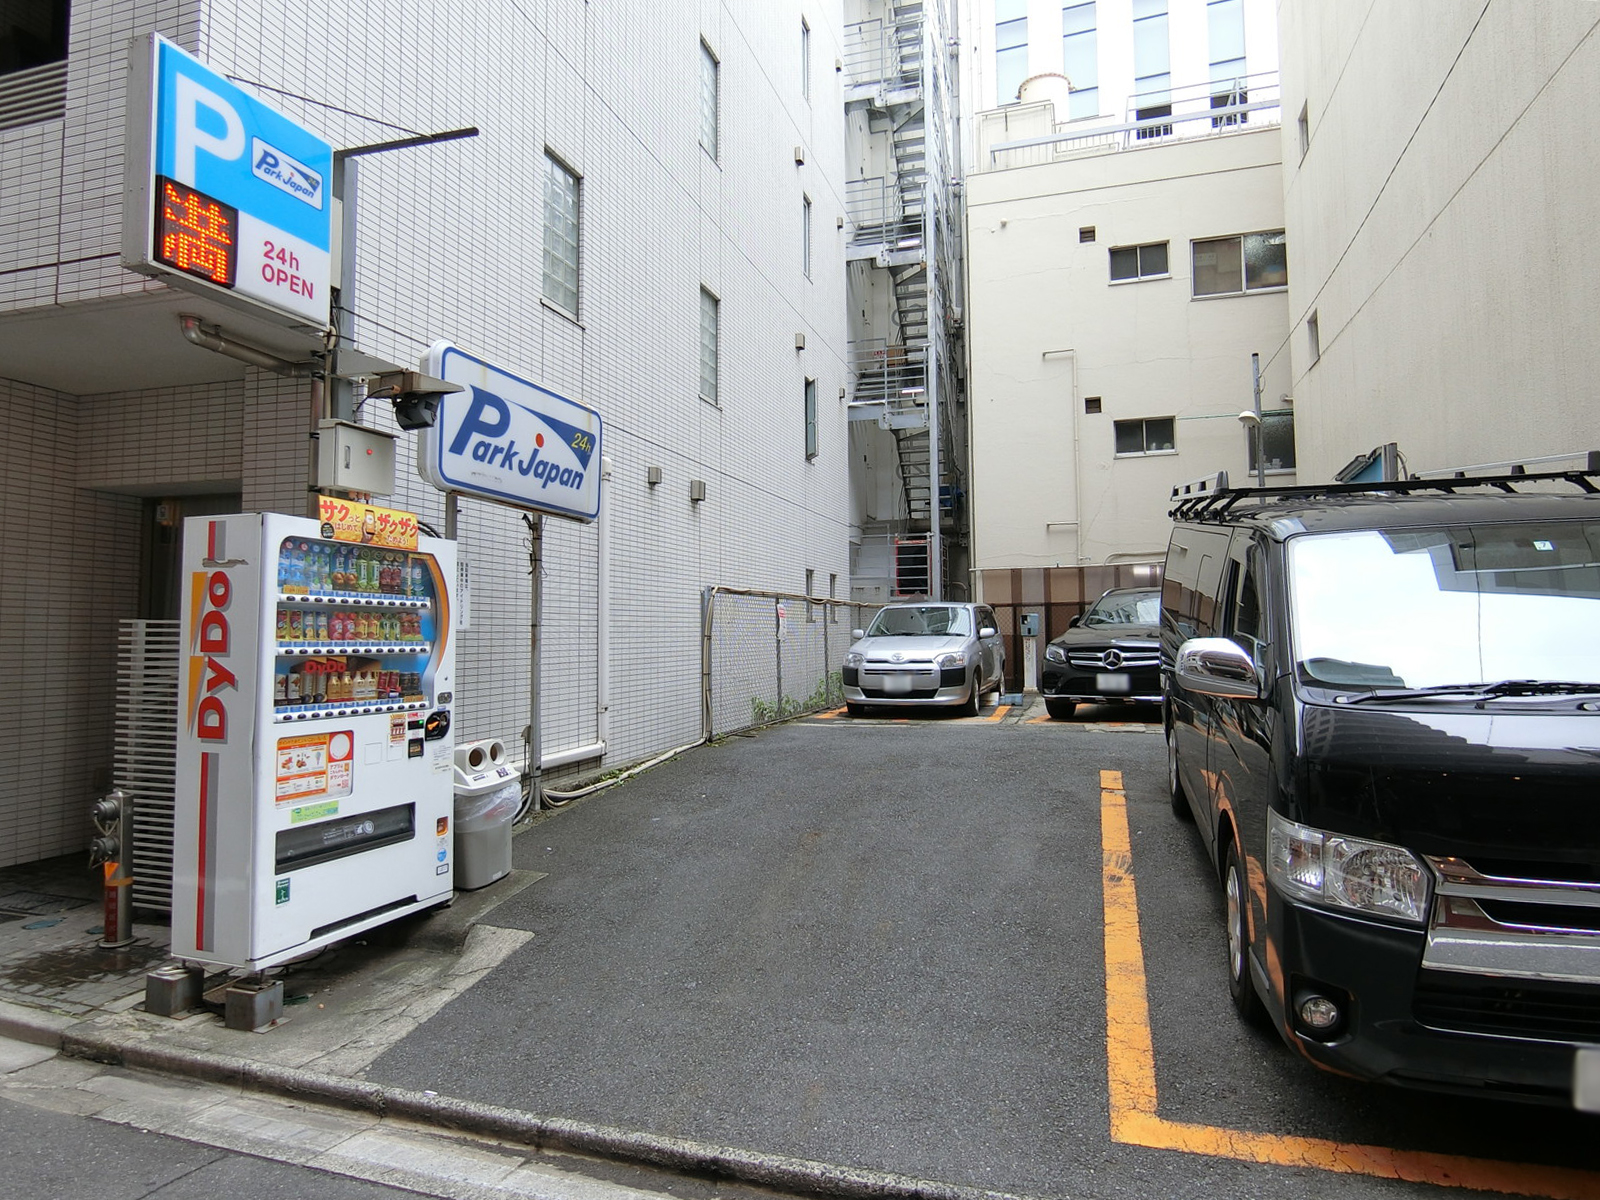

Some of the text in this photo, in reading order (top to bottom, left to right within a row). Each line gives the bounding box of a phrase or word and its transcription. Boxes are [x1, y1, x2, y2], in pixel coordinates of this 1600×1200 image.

[175, 71, 246, 190] P
[164, 182, 233, 284] 満
[263, 240, 299, 271] 24h
[261, 263, 314, 300] OPEN
[377, 513, 418, 538] ザクザク
[197, 570, 236, 740] DyDo
[305, 659, 347, 676] DyDo
